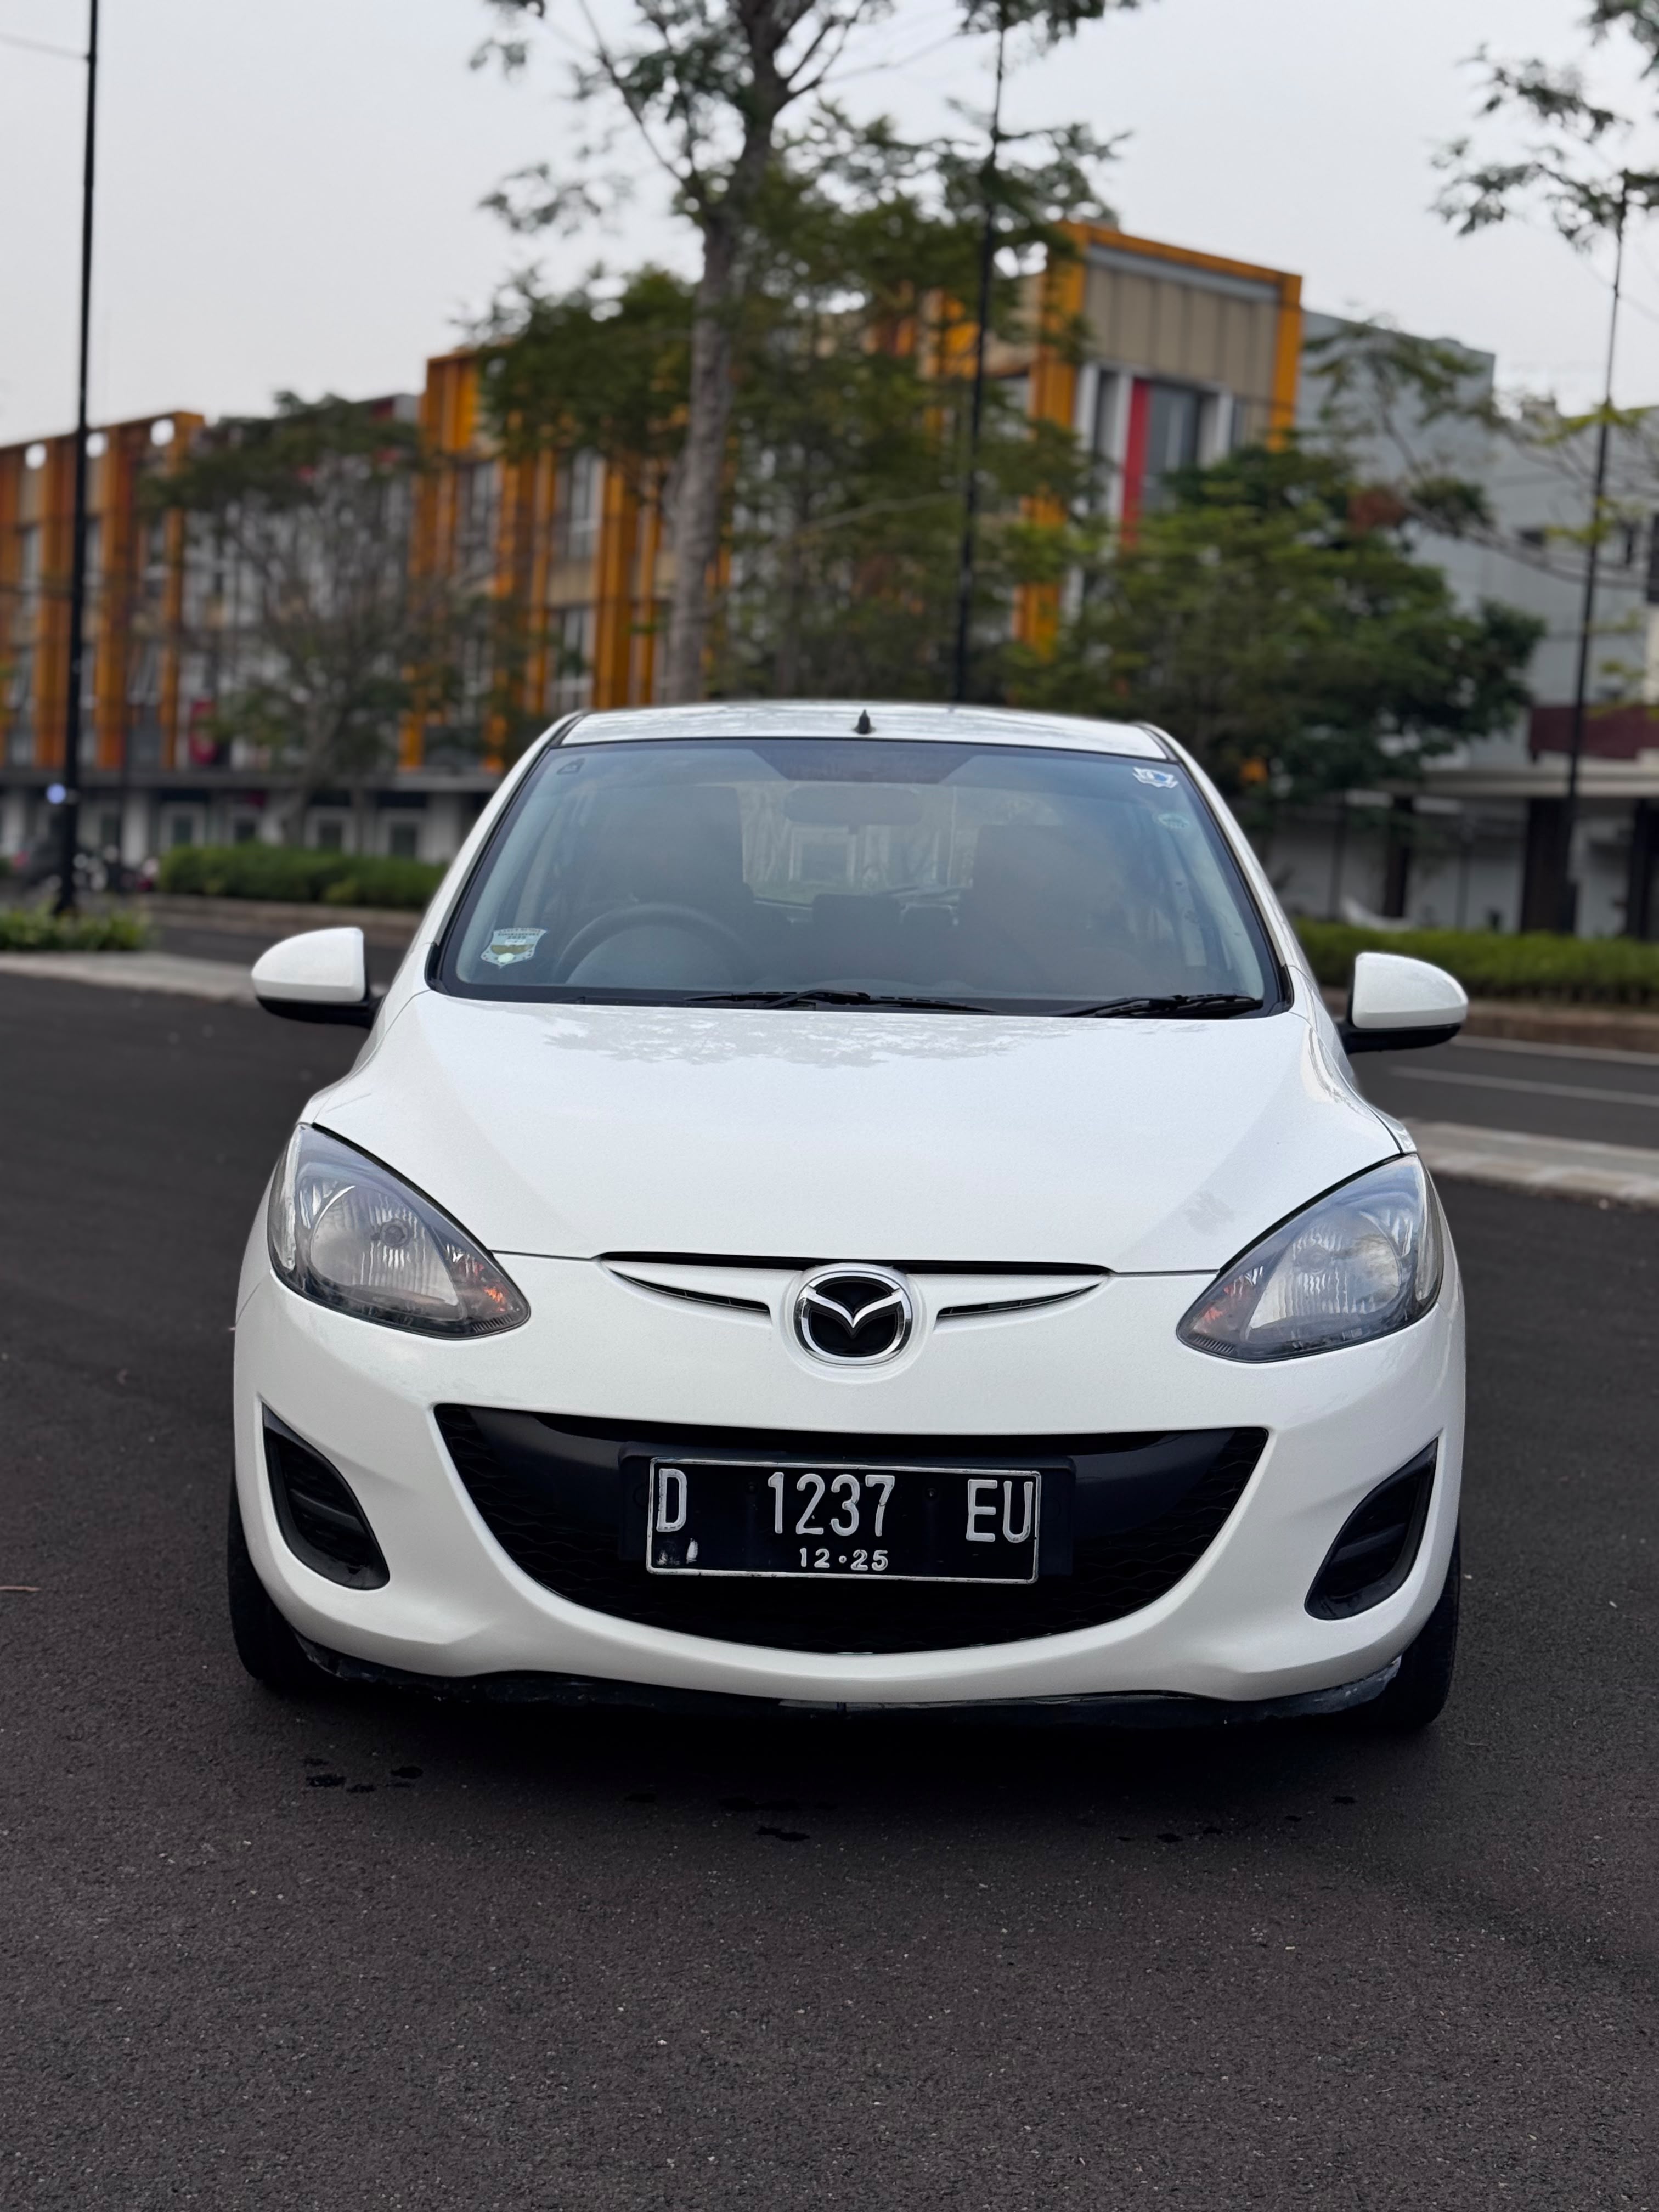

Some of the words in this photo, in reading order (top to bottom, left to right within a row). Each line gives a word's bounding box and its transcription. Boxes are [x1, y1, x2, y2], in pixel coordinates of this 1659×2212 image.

[656, 1468, 687, 1532] D
[768, 1472, 895, 1536] 1237
[966, 1479, 1033, 1543] EU
